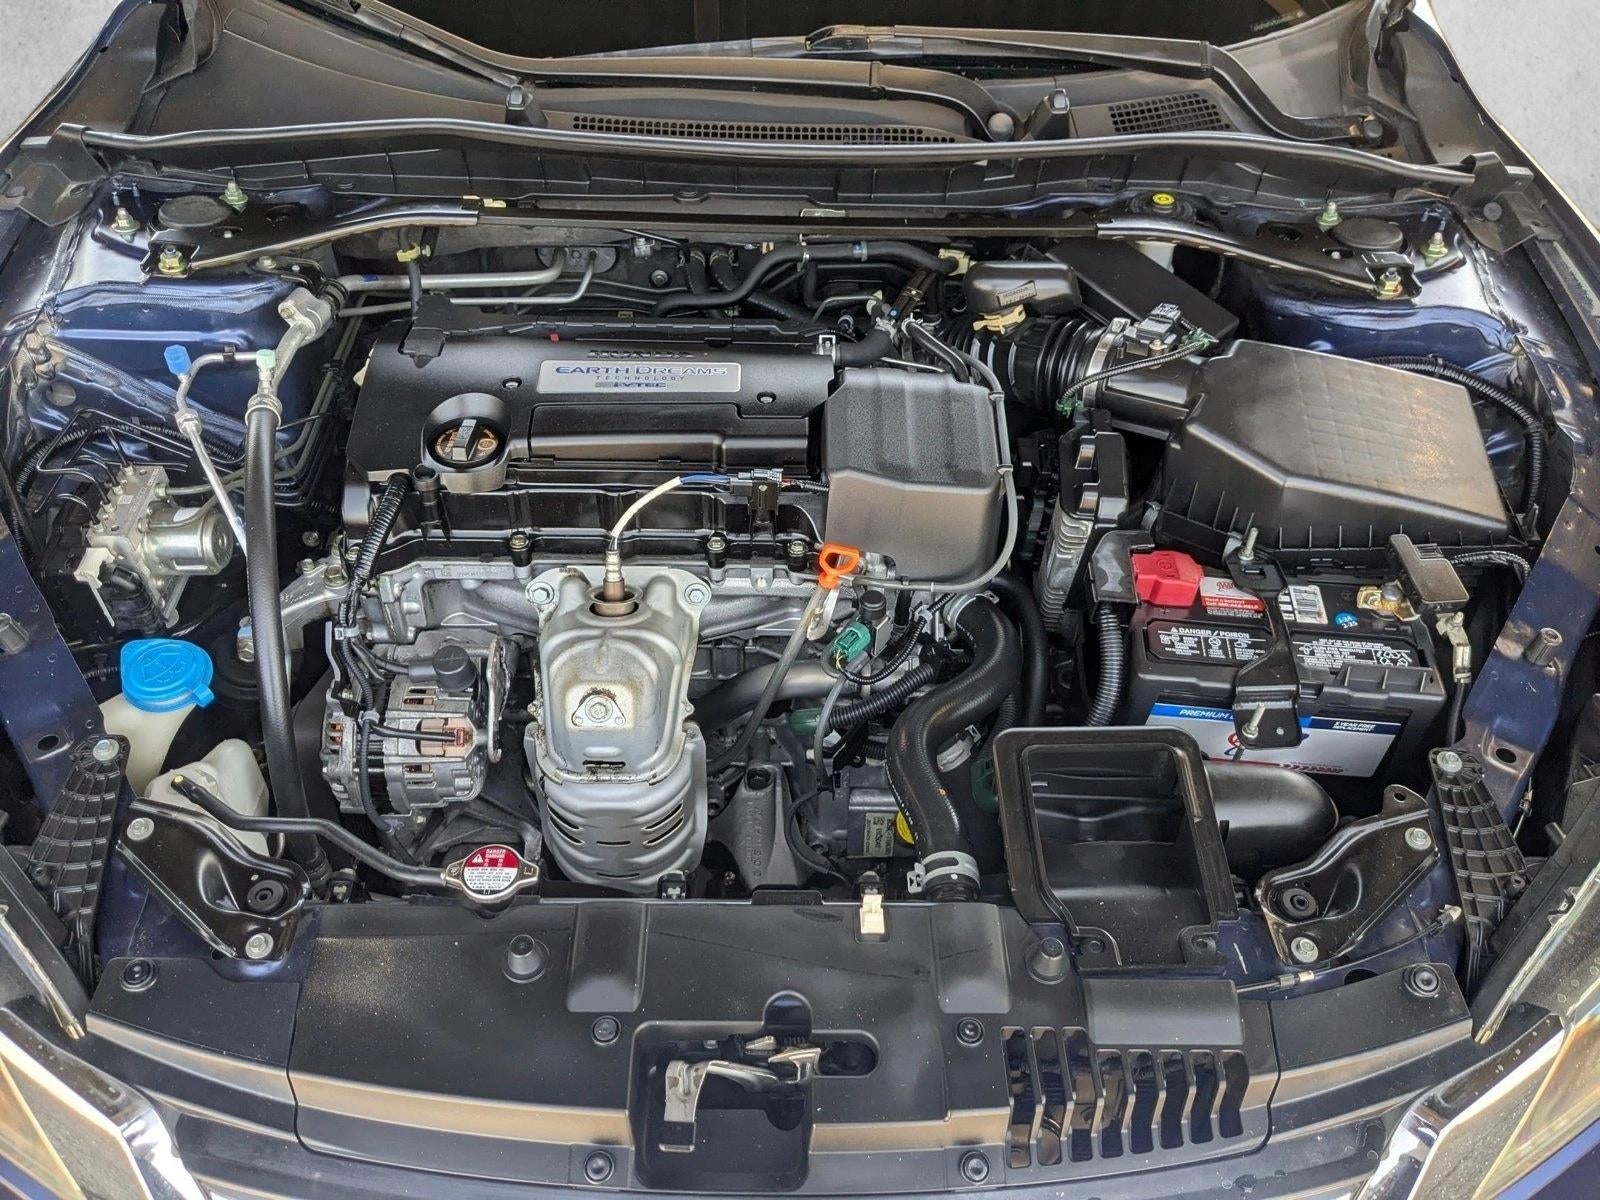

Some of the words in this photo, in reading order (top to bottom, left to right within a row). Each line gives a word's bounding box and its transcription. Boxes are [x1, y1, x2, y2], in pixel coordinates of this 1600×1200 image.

[556, 366, 630, 375] EARTH
[636, 366, 728, 376] DREAMS
[1178, 627, 1212, 636] DANGER
[1219, 631, 1250, 639] POISON
[1179, 709, 1230, 719] PREMIUM
